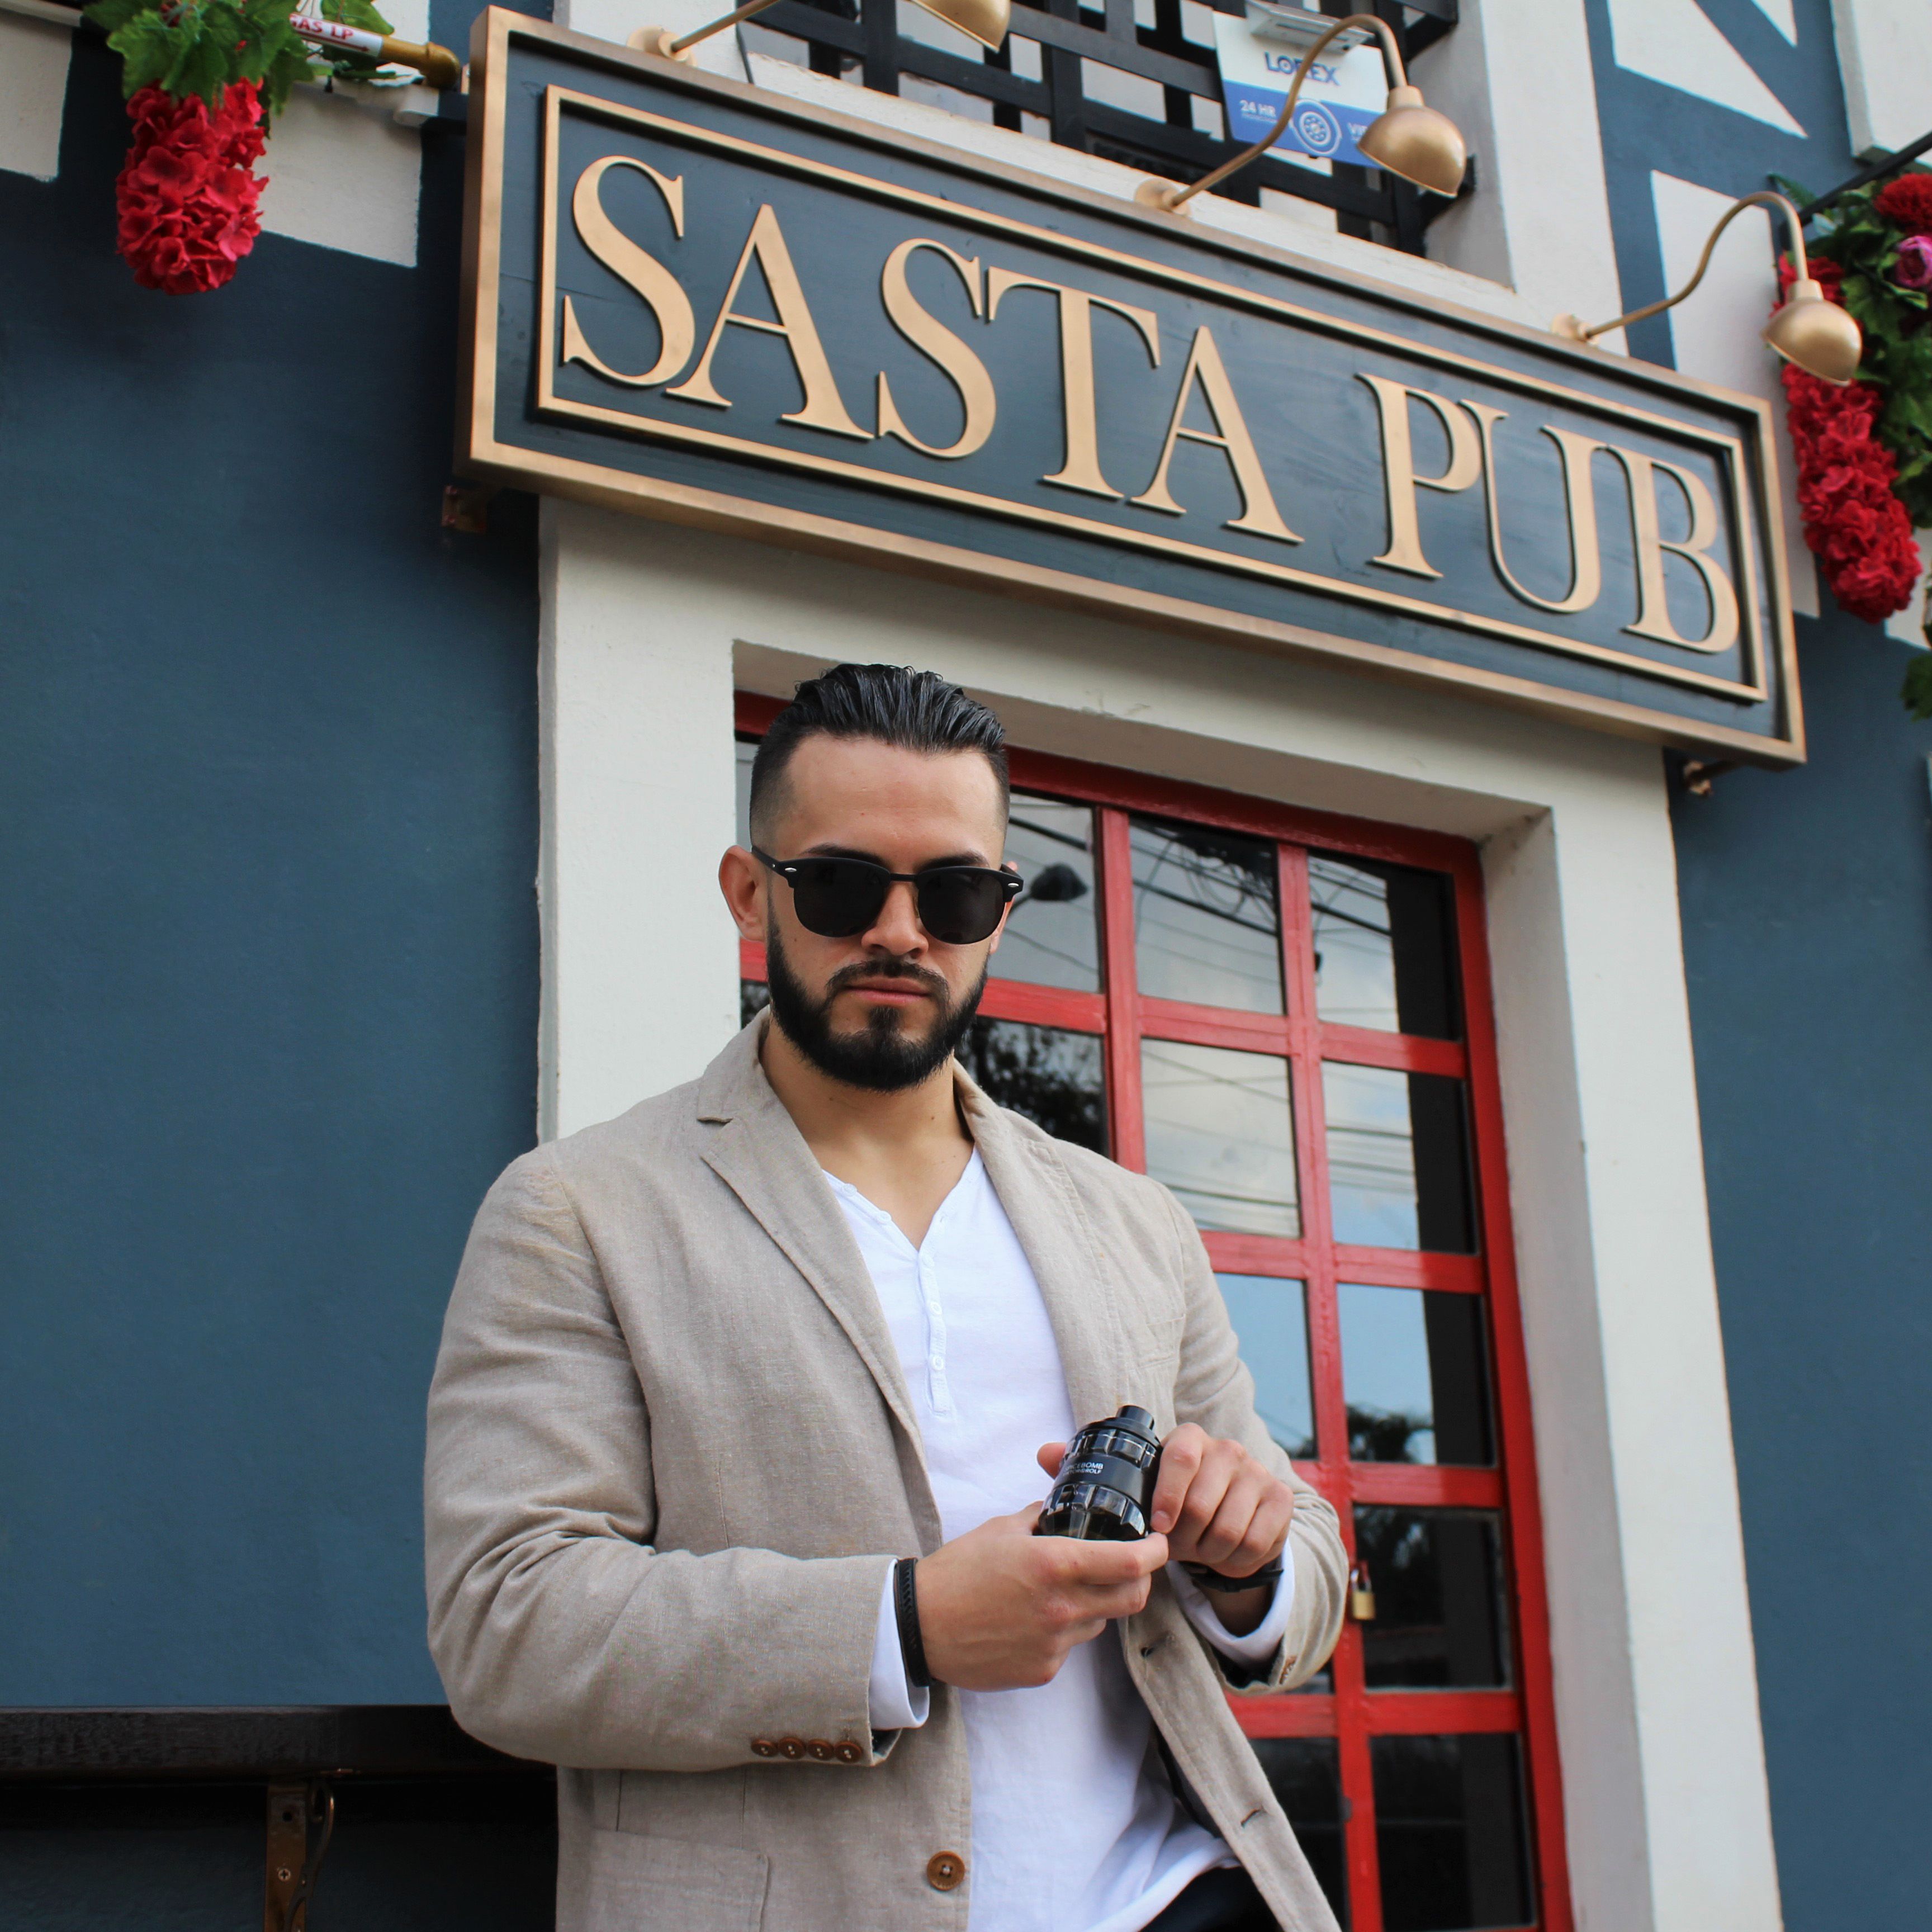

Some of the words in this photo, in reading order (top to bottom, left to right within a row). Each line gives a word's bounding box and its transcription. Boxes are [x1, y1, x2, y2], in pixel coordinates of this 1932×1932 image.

[330, 25, 353, 40] LP
[1239, 100, 1256, 113] 24
[1258, 103, 1276, 117] HR
[564, 155, 1304, 544] SASTA
[1355, 372, 1739, 654] PUB
